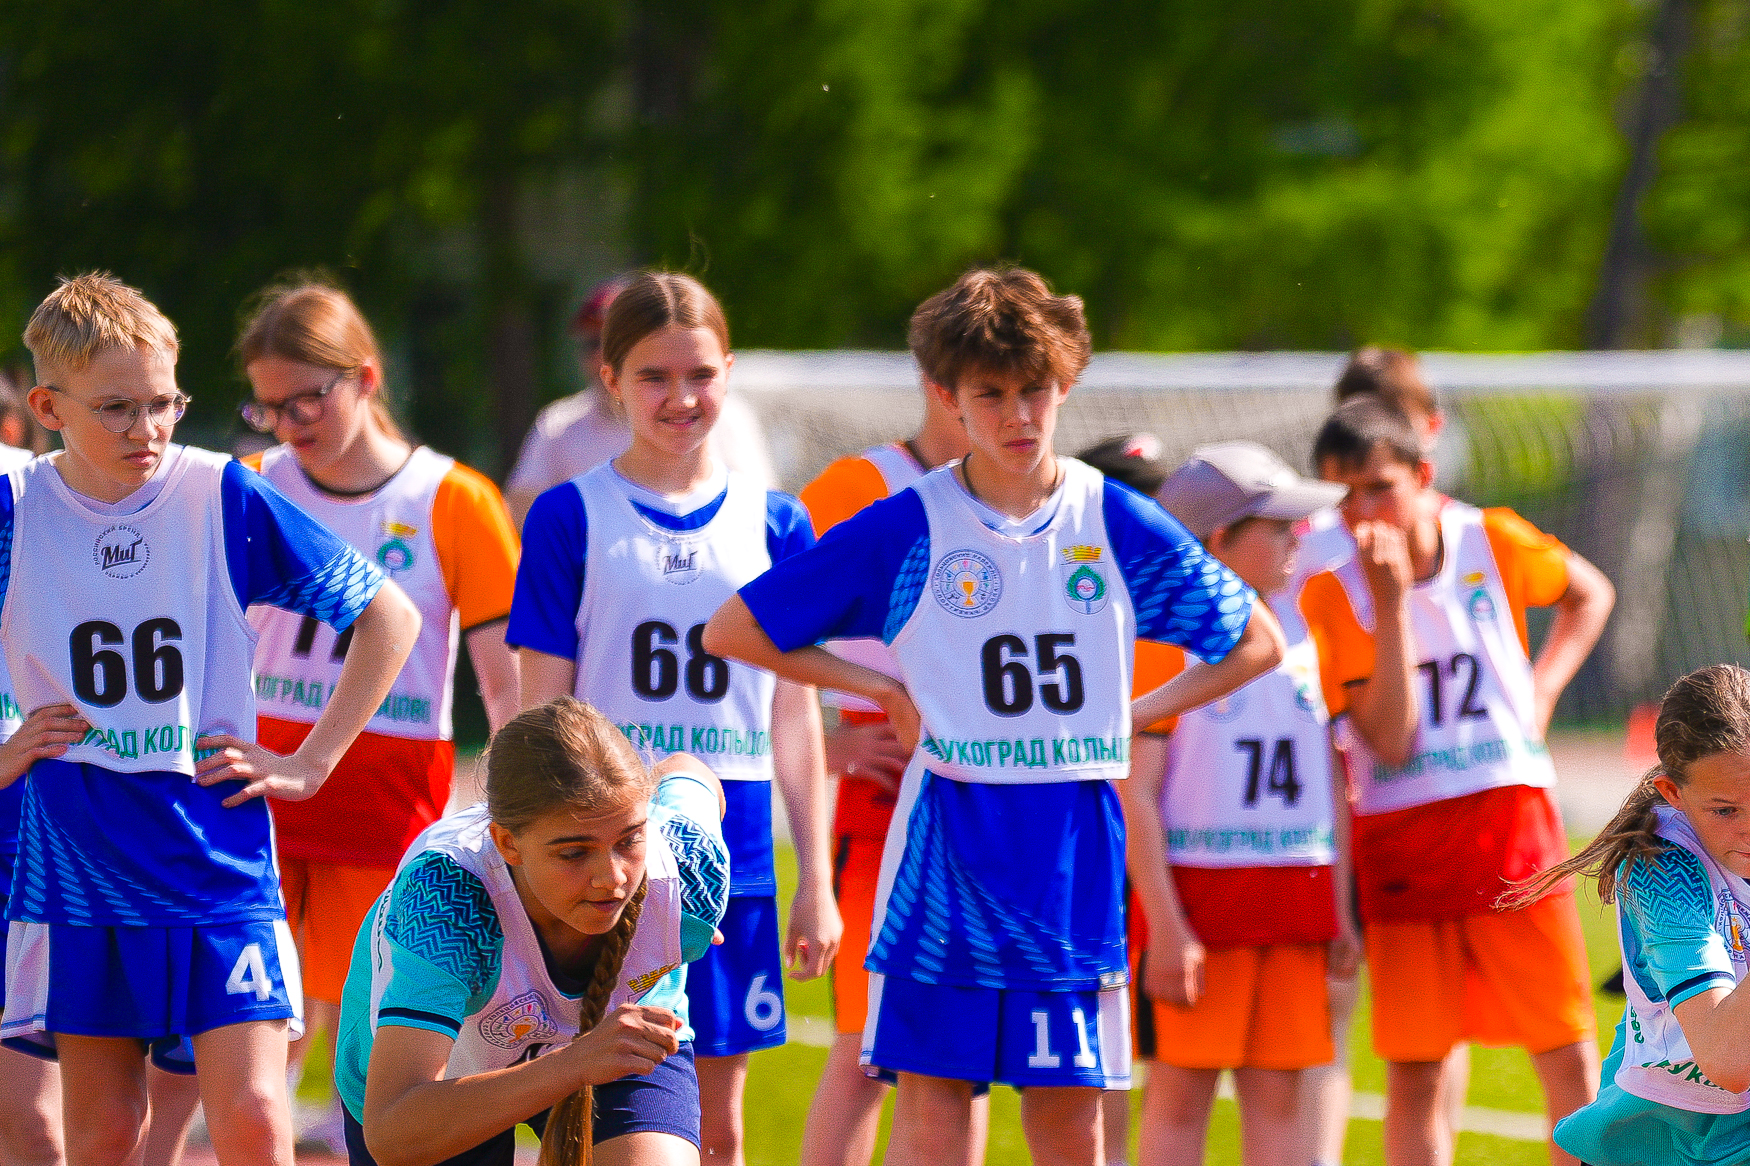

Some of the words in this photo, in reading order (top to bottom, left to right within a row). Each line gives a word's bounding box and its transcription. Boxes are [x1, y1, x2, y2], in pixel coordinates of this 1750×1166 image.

[69, 617, 184, 709] 66
[631, 620, 730, 706] 68
[981, 633, 1085, 719] 65
[1234, 736, 1304, 809] 74
[225, 943, 272, 1001] 4
[745, 974, 782, 1031] 6
[1028, 1008, 1097, 1068] 11
